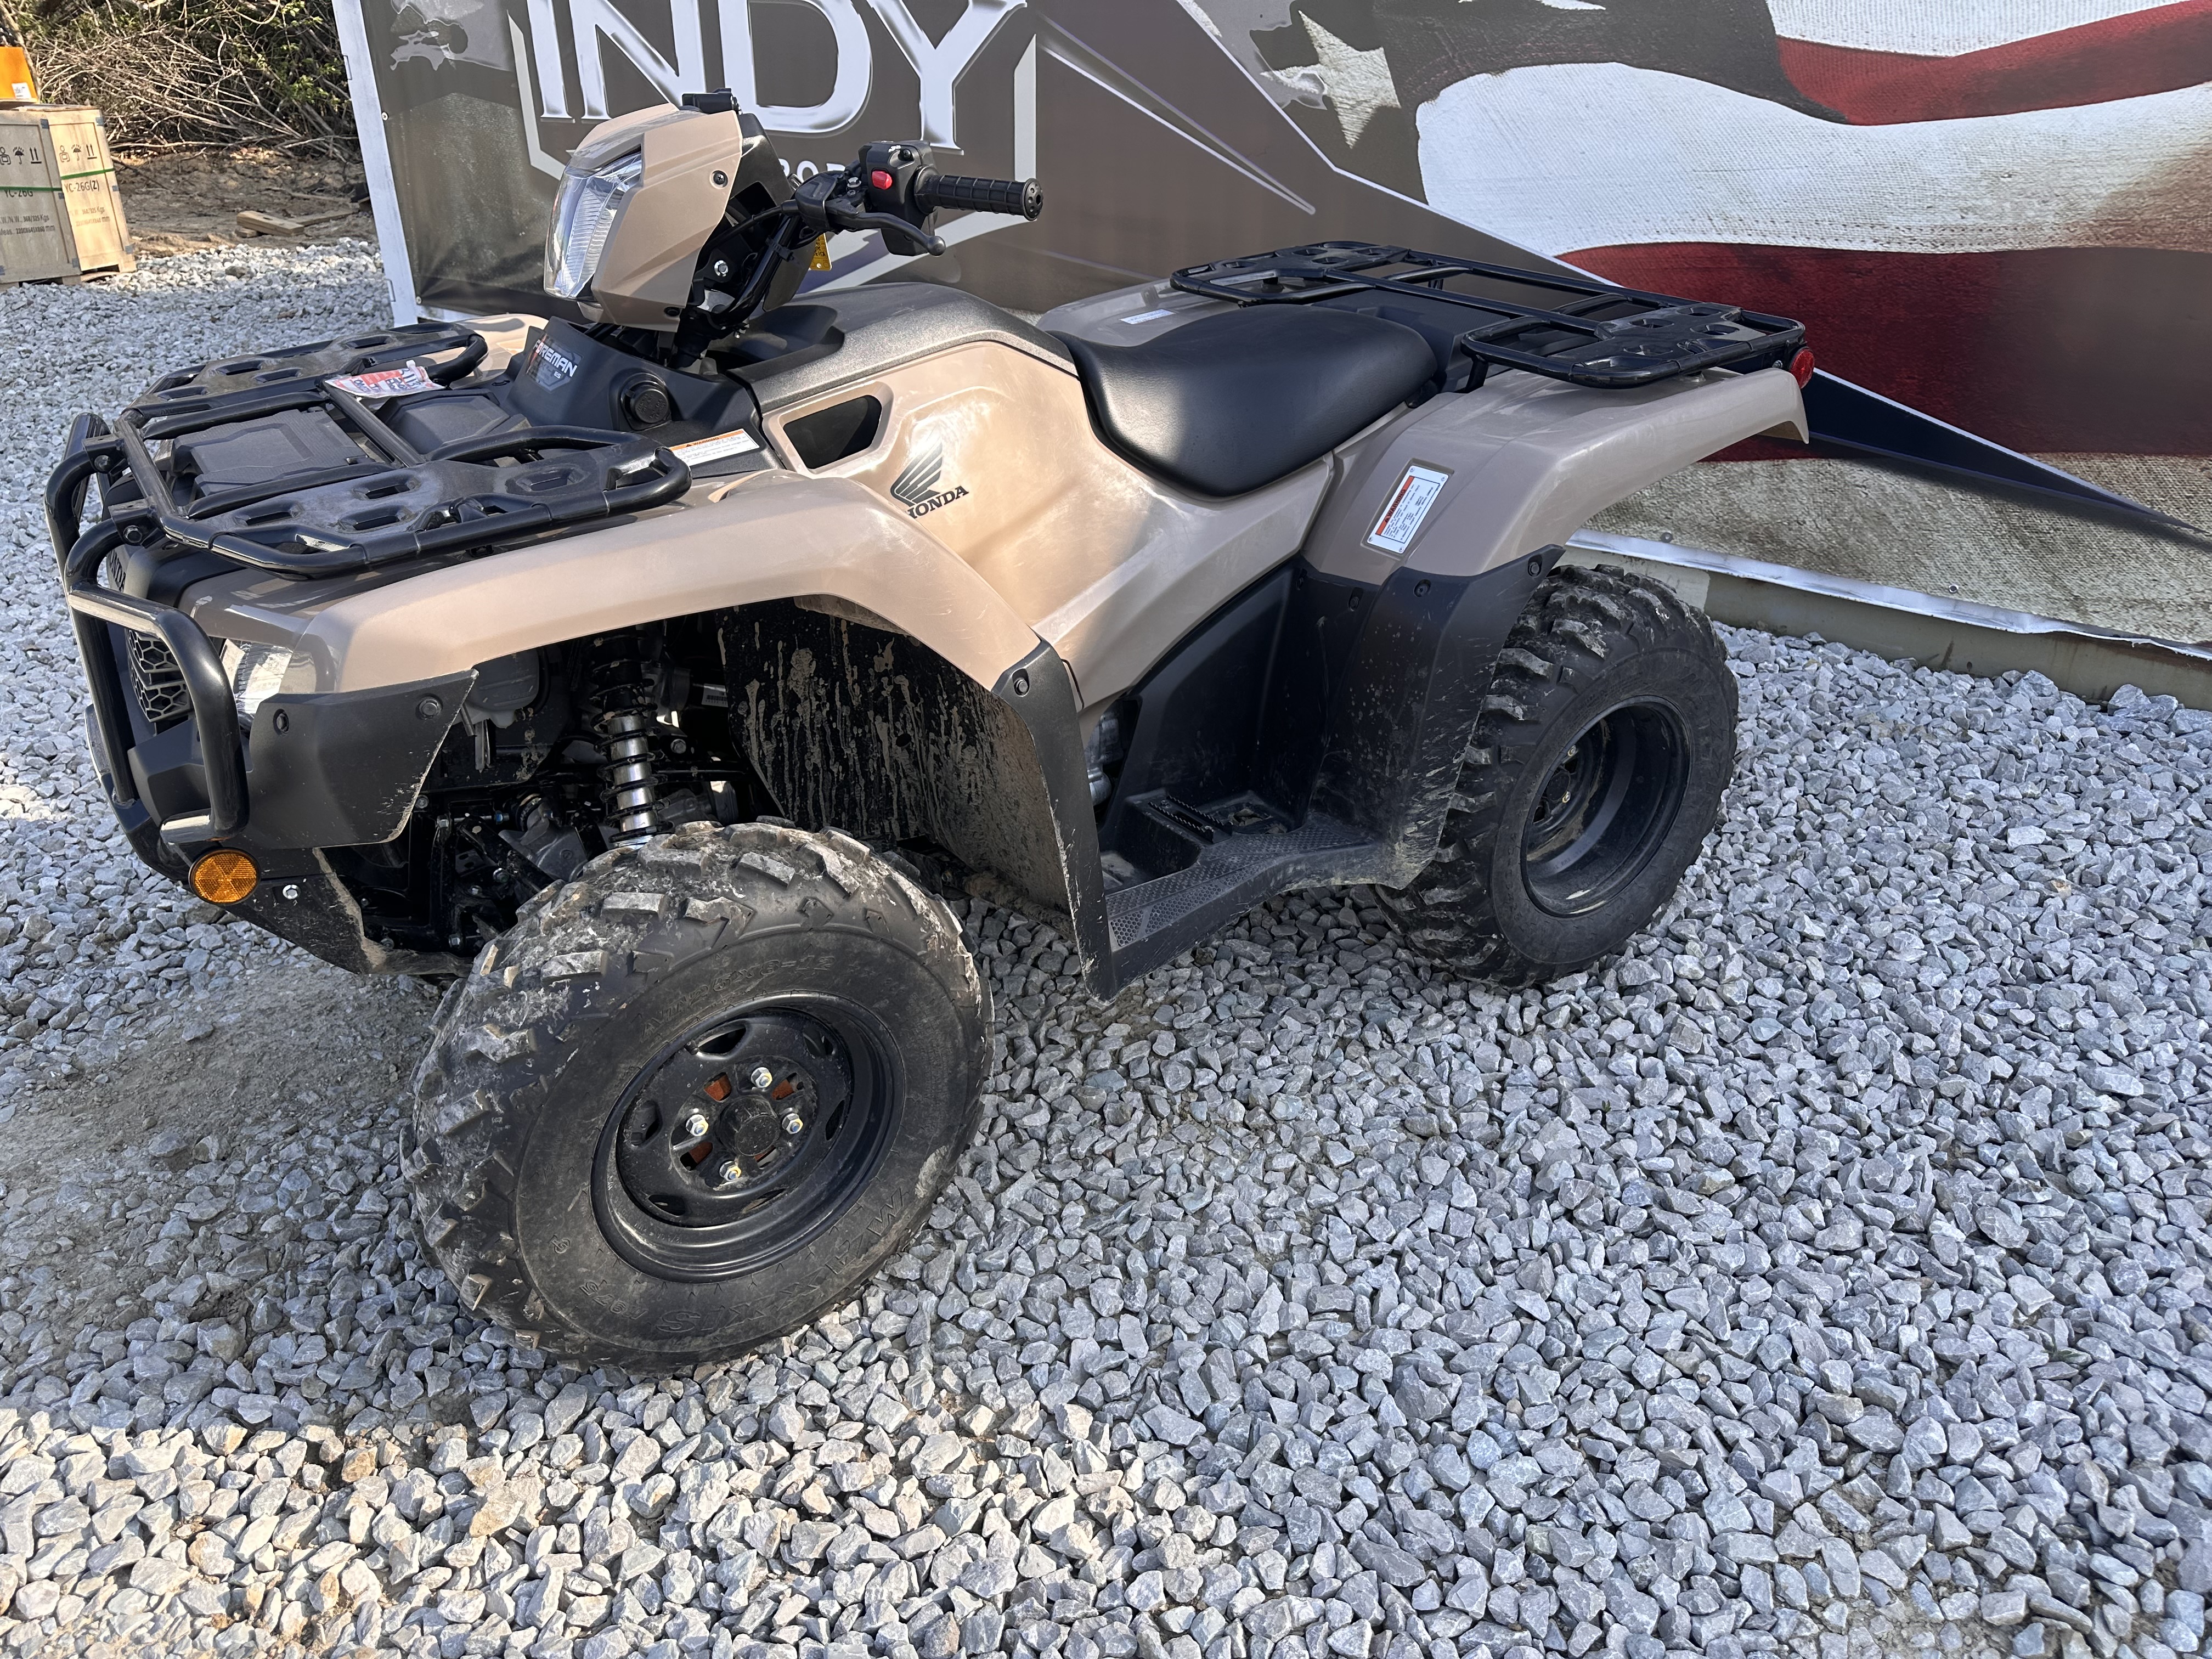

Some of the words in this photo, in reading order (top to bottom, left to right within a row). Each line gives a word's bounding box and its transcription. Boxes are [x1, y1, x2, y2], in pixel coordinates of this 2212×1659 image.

[527, 0, 1028, 156] INDY
[64, 179, 100, 192] YC-26G(Z)
[533, 339, 577, 377] FOREMAN
[1387, 489, 1406, 517] WARNING
